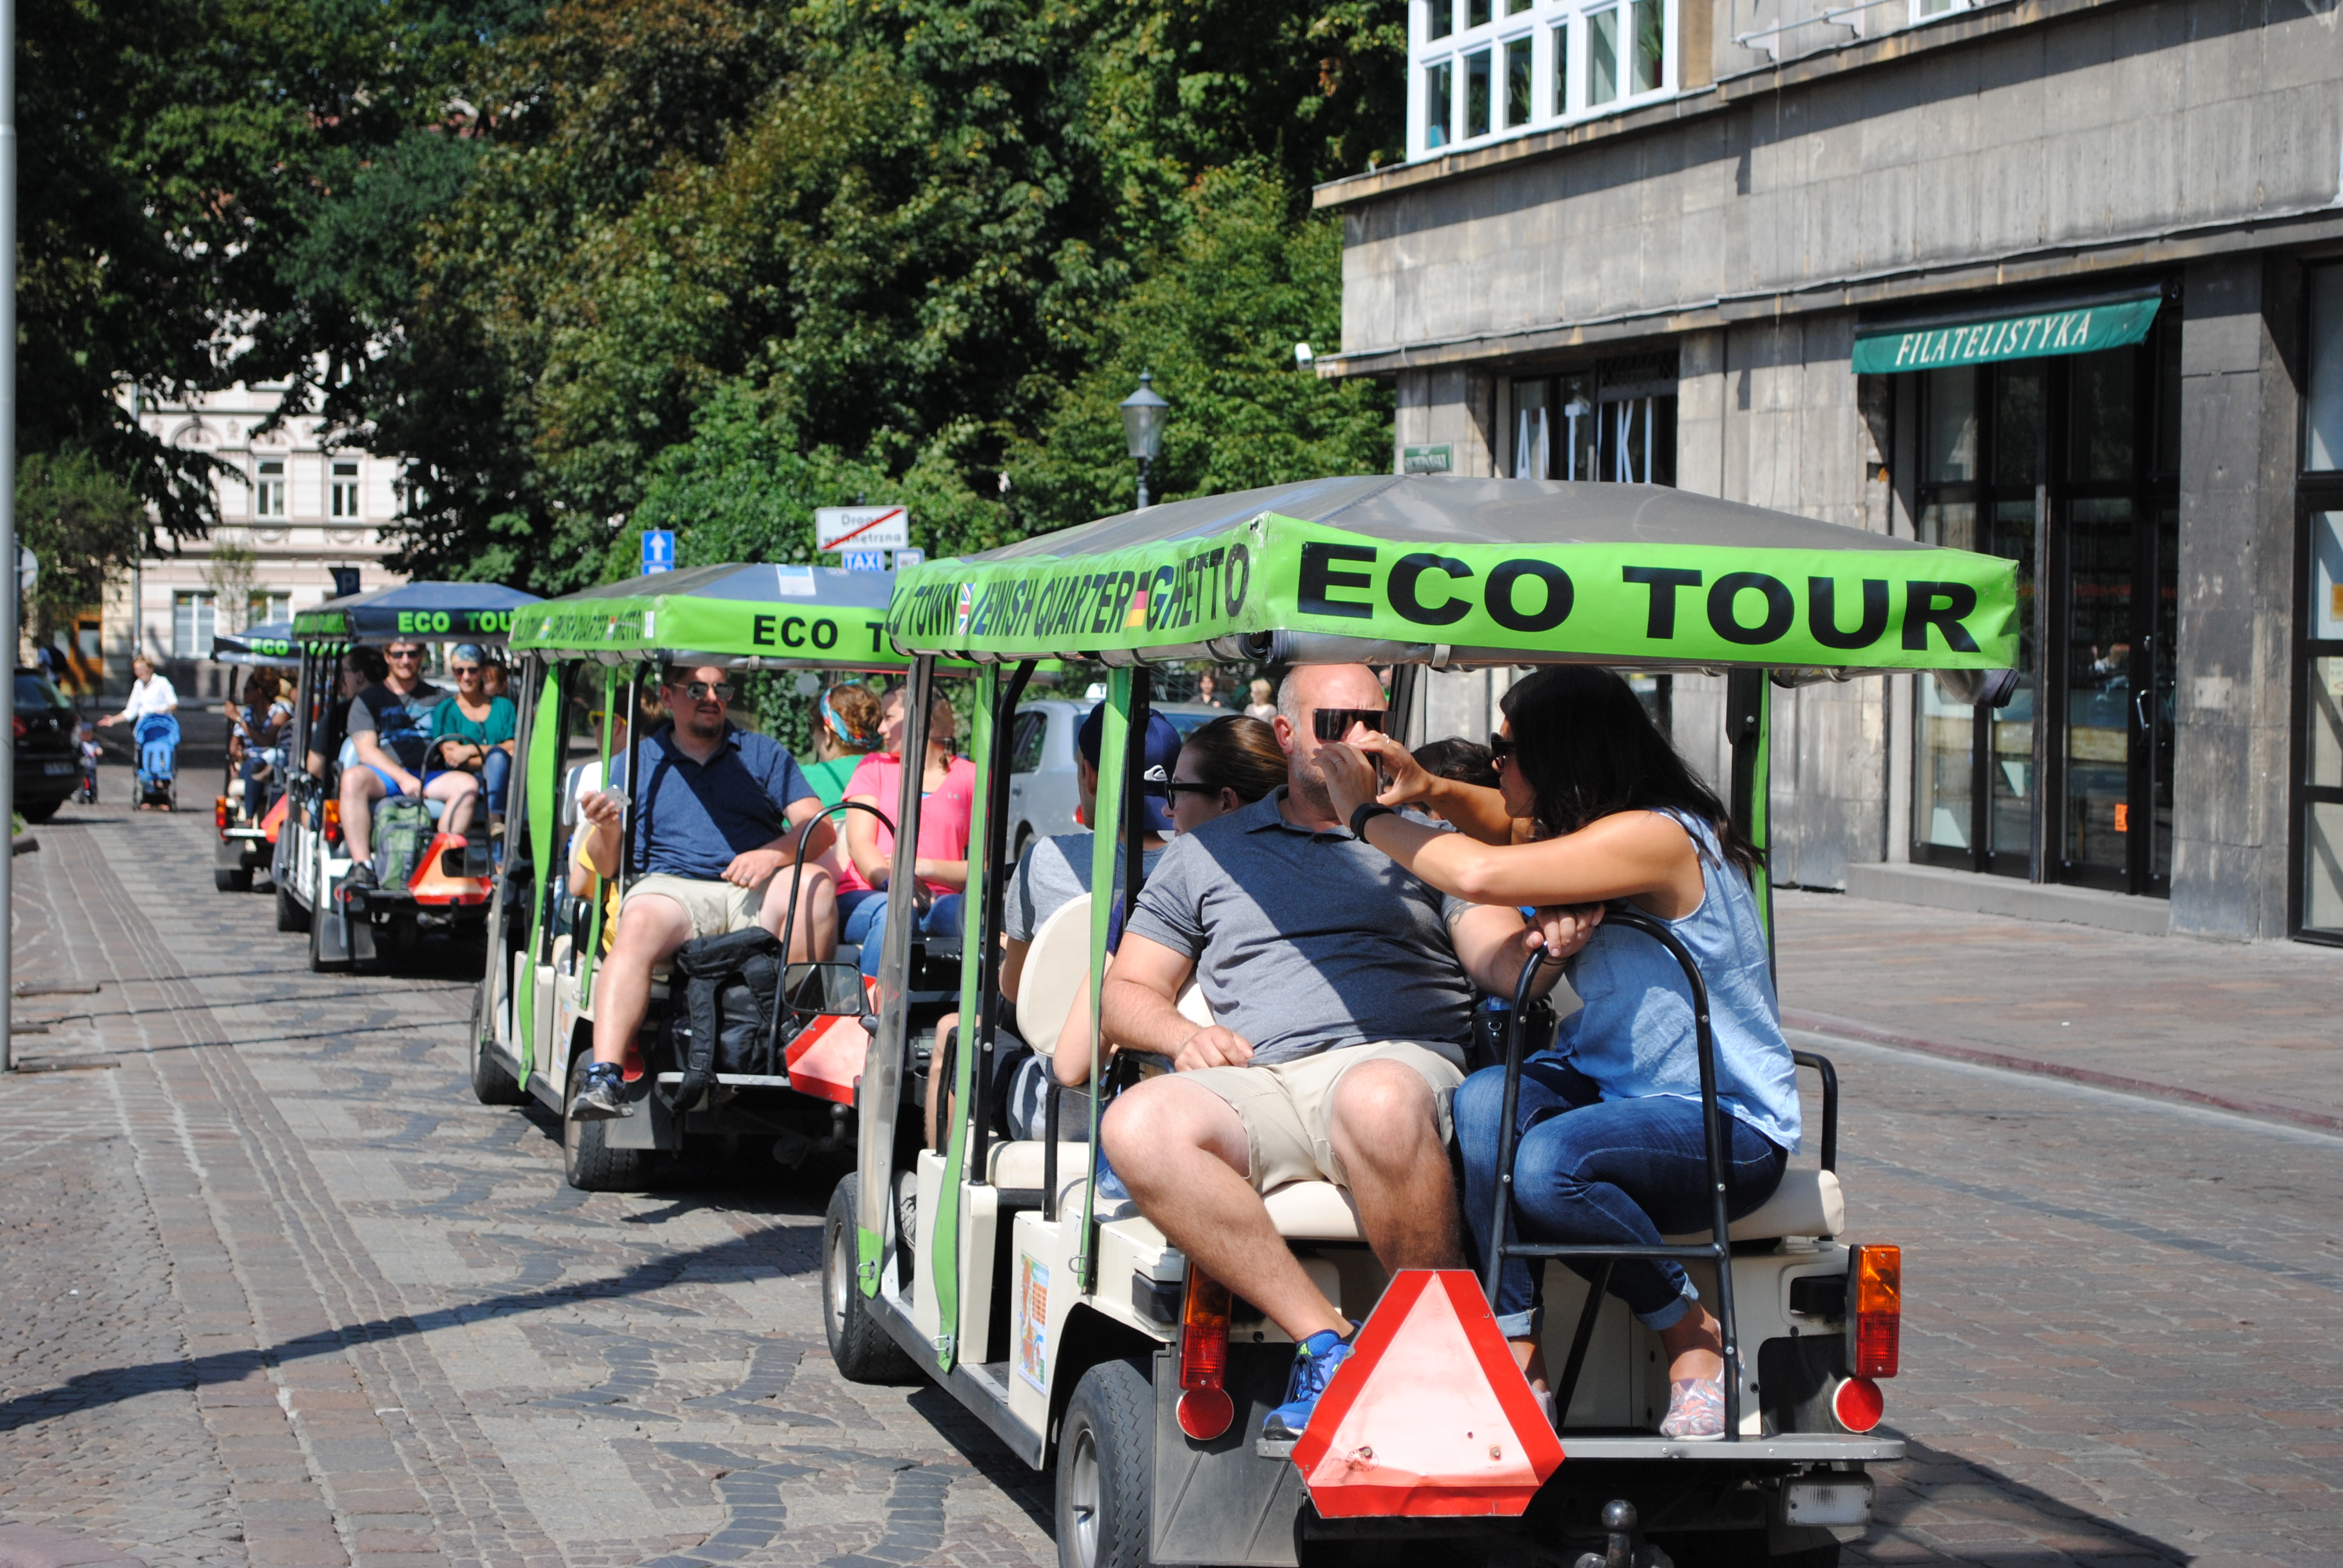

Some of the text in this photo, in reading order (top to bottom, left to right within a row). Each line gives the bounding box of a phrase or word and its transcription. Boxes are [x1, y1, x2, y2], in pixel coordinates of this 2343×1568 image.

[1895, 311, 2091, 366] FILATELISTYKA
[824, 532, 901, 547] wenętrzna
[844, 552, 882, 570] TAXI
[909, 581, 962, 636] TOWN
[968, 579, 1039, 636] JEWISH
[1034, 570, 1136, 642] QUARTER
[1147, 543, 1249, 632] GHETTO
[1297, 541, 1981, 653] ECO TOUR
[398, 611, 450, 633] ECO
[465, 611, 514, 633] TOU
[753, 614, 837, 649] ECO
[250, 638, 289, 656] ECO
